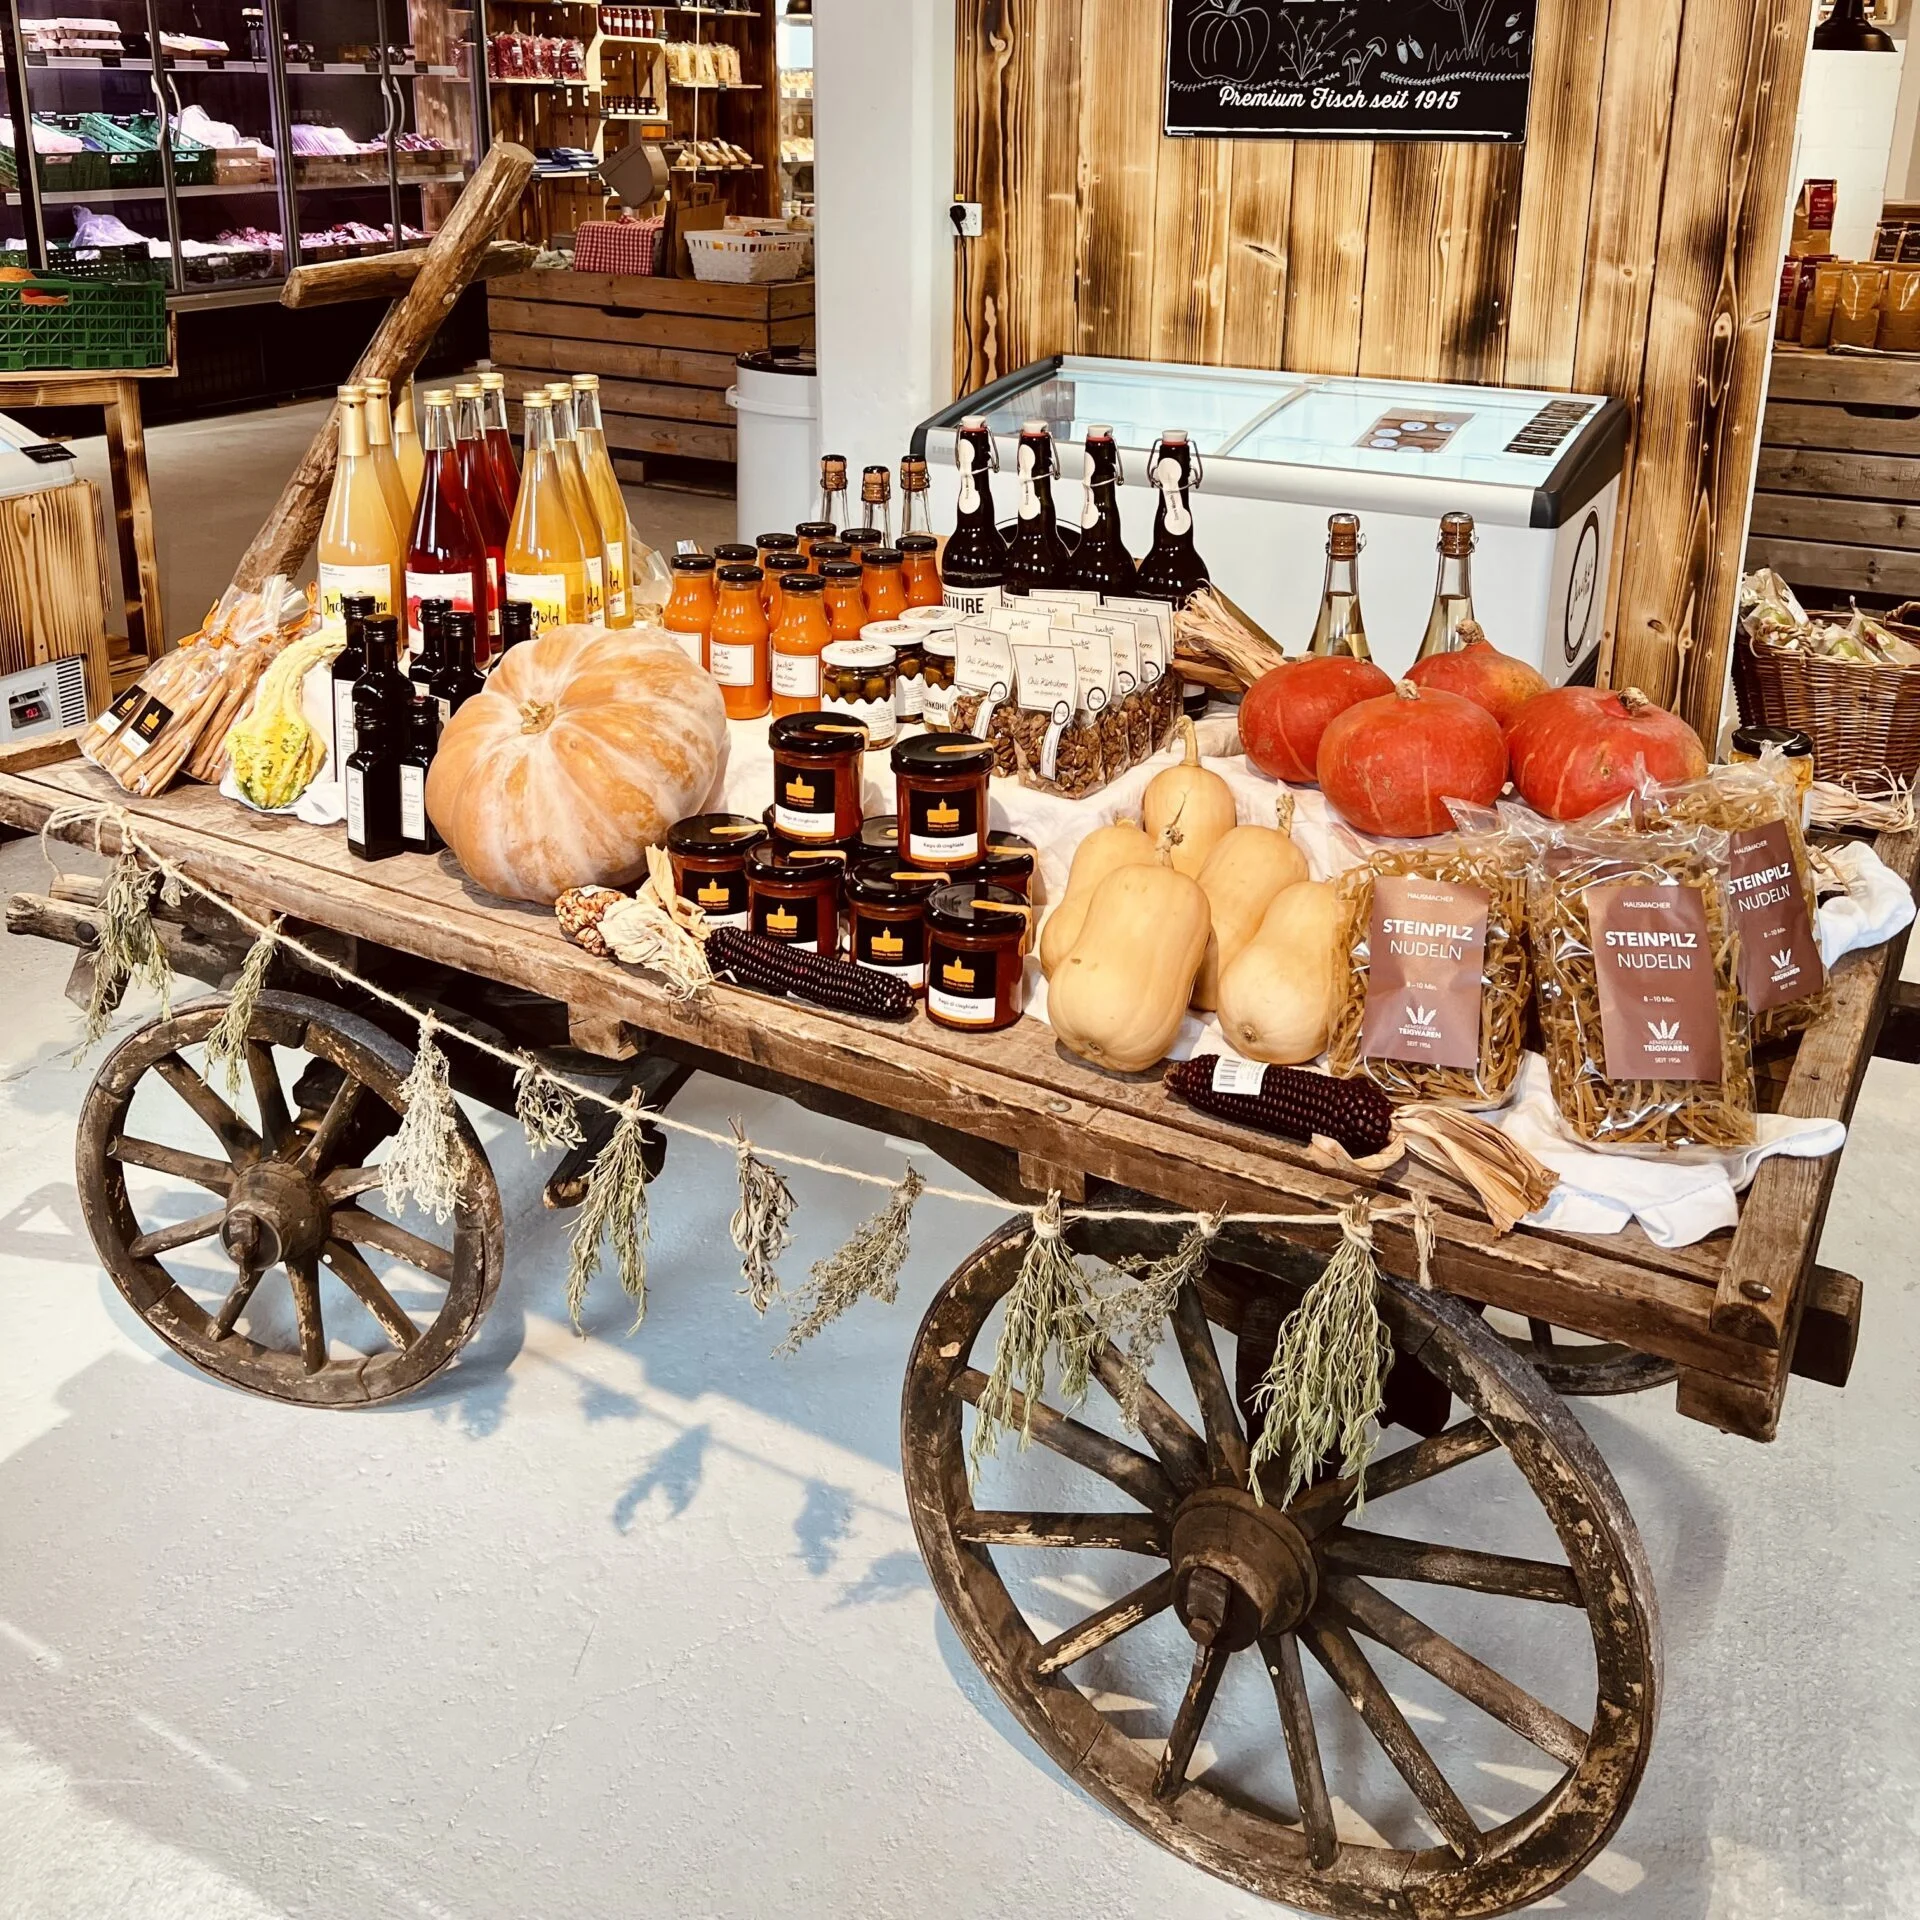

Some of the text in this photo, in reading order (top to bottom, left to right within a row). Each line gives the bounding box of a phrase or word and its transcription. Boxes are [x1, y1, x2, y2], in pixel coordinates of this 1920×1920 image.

[1218, 86, 1461, 110] Premium Fisch seit 1915
[1733, 840, 1768, 856] HAUSMACHER
[1728, 862, 1792, 895] STEINPILZ
[1407, 892, 1454, 903] HAUSMACHER
[1623, 901, 1671, 909] HAUSMACHER
[1738, 883, 1791, 913] NUDELN
[1382, 919, 1474, 941] STEINPILZ
[1605, 931, 1698, 948] STEINPILZ
[1390, 942, 1462, 961] NUDELN
[1617, 953, 1691, 970] NUDELN
[1398, 1028, 1442, 1038] TEIGWAREN
